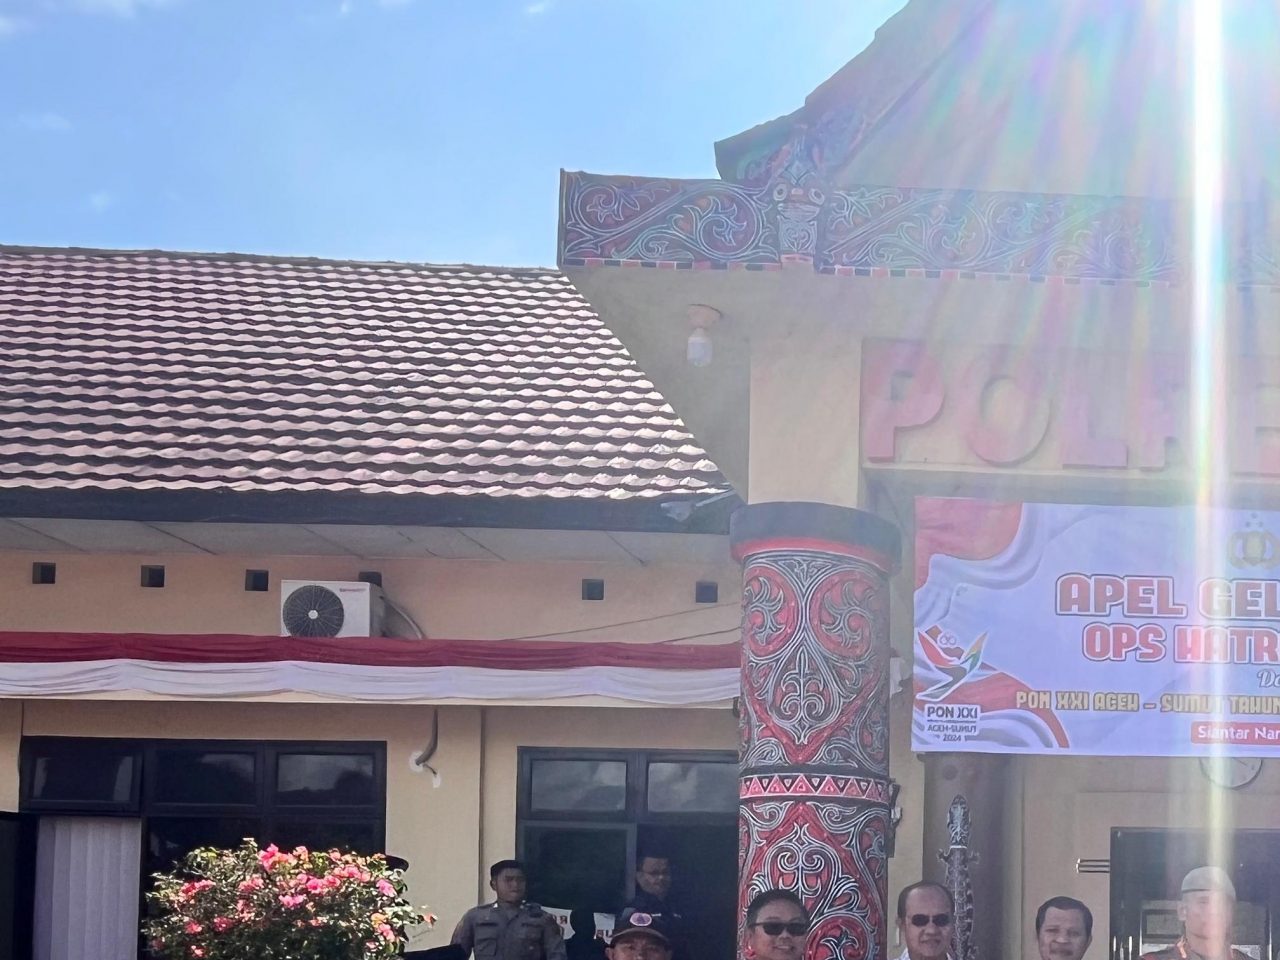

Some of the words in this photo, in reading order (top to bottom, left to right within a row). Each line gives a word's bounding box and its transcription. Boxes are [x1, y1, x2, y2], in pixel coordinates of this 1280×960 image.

[1056, 573, 1187, 617] APEL
[1082, 622, 1166, 662] OPS
[927, 706, 954, 718] PON
[957, 707, 978, 719] XXI
[1016, 691, 1050, 709] PON
[1055, 691, 1090, 710] XXI
[1093, 692, 1139, 711] ACEH
